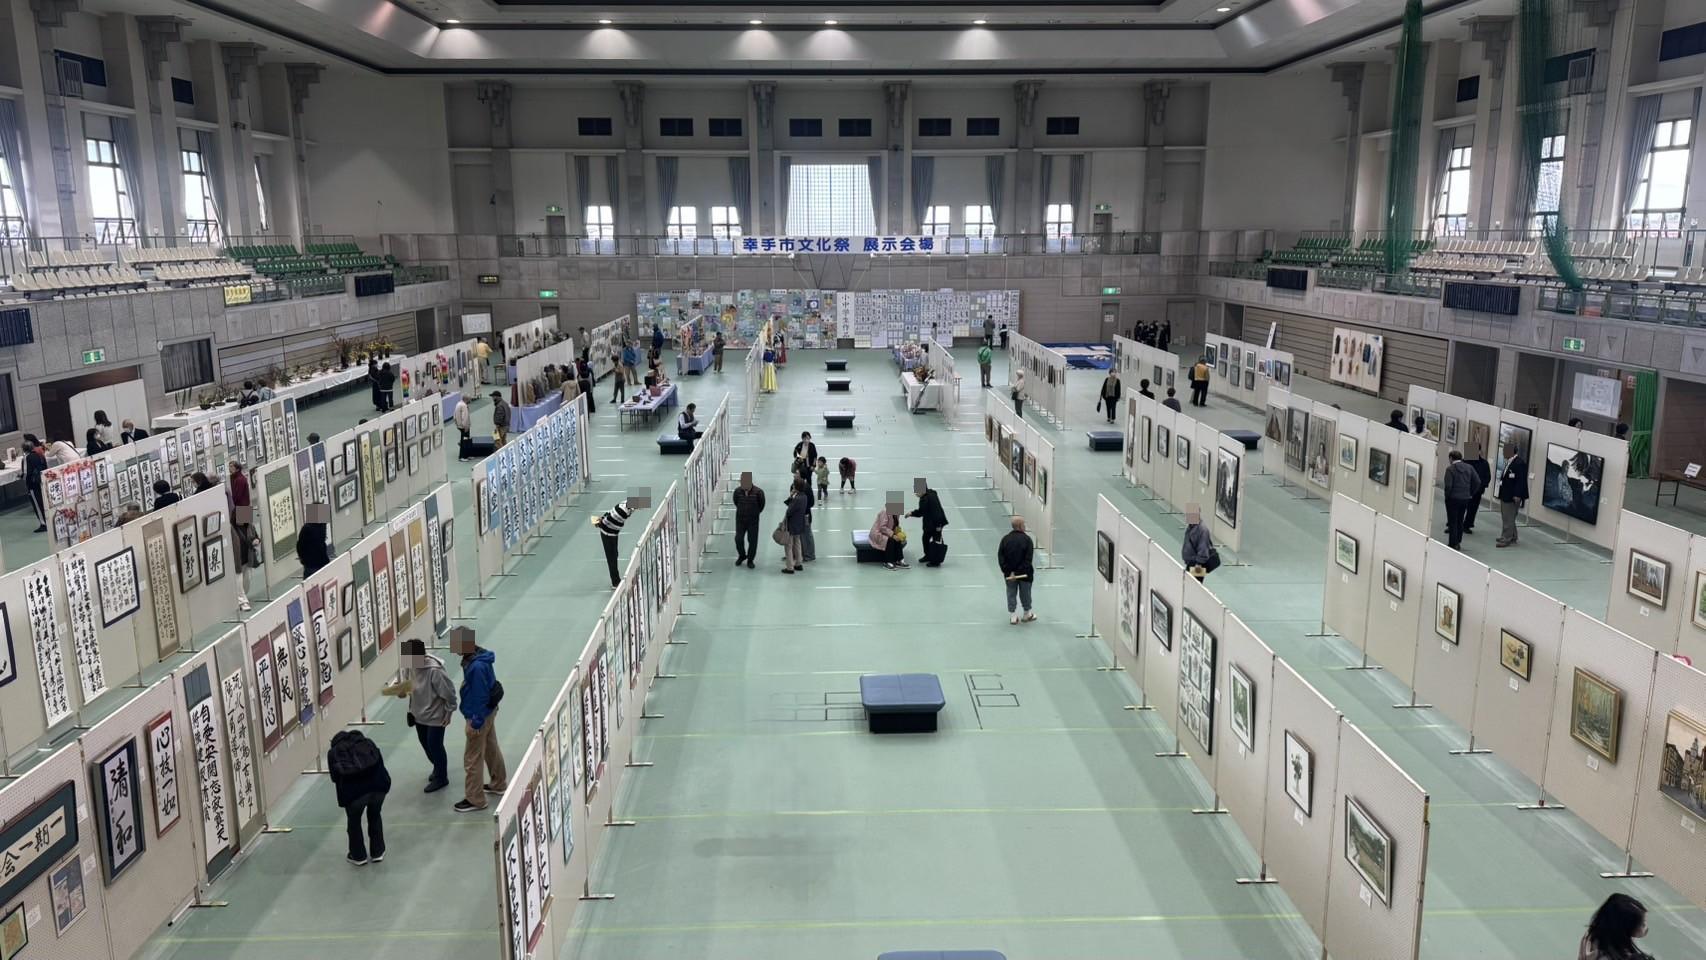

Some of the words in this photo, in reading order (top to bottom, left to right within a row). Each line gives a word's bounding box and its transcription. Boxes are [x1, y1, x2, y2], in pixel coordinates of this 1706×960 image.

[743, 237, 850, 251] 幸手市文化祭
[863, 237, 934, 251] 展示会場
[259, 659, 276, 727] 平常心
[157, 726, 176, 817] 心技一如
[0, 815, 63, 877] 一期一会
